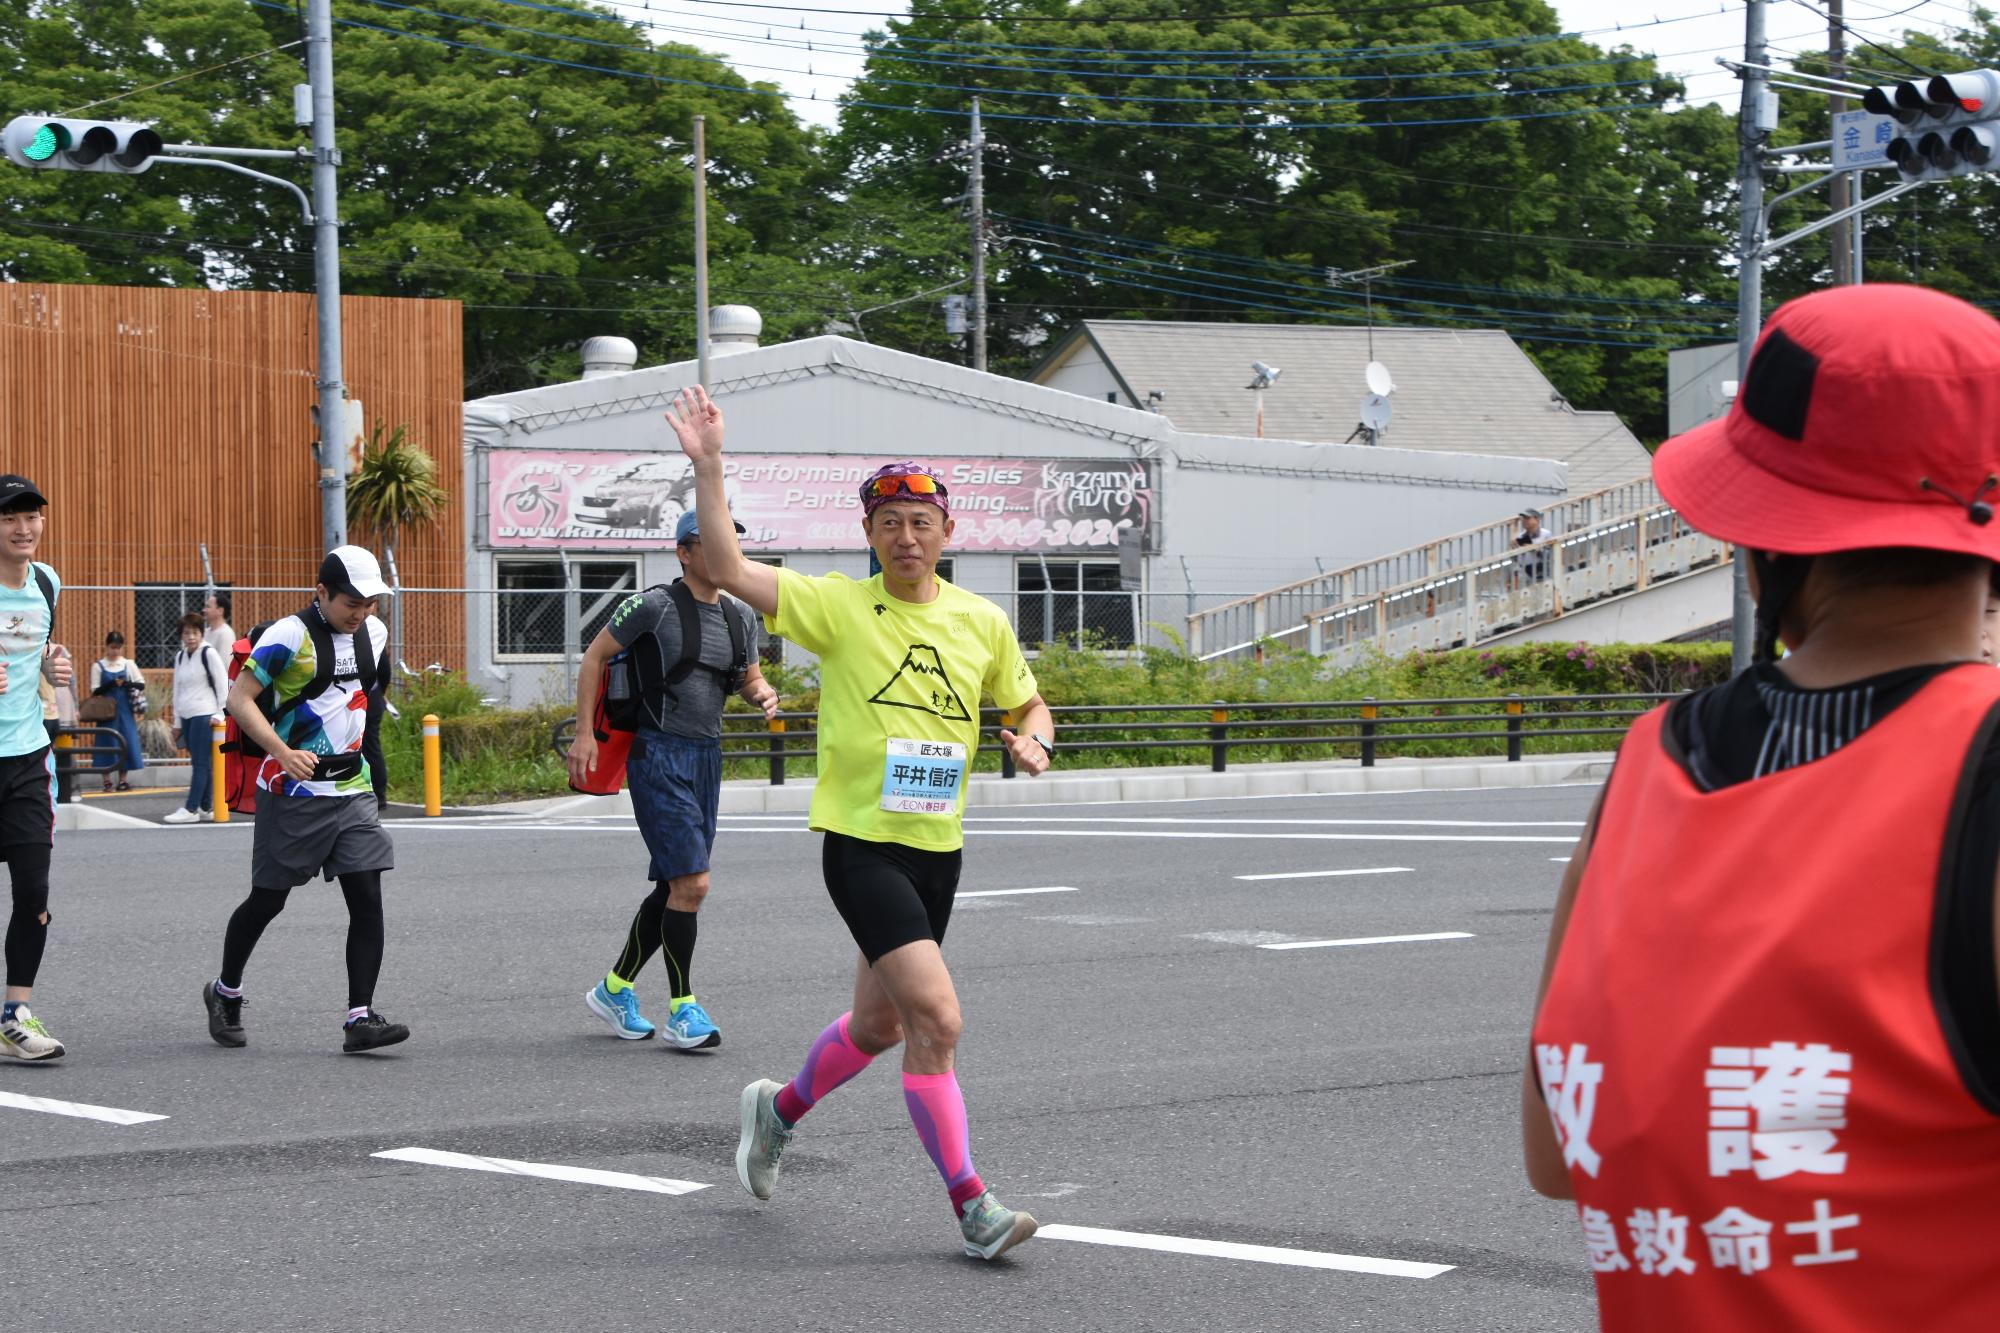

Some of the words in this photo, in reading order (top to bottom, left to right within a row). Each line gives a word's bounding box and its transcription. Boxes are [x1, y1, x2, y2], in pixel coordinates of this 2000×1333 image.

[723, 462, 877, 483] Performanc
[951, 464, 1023, 485] Sales
[783, 489, 859, 508] Parts
[1068, 488, 1133, 515] AUTO
[920, 744, 953, 757] 匠大塚
[892, 764, 958, 788] 平井信行
